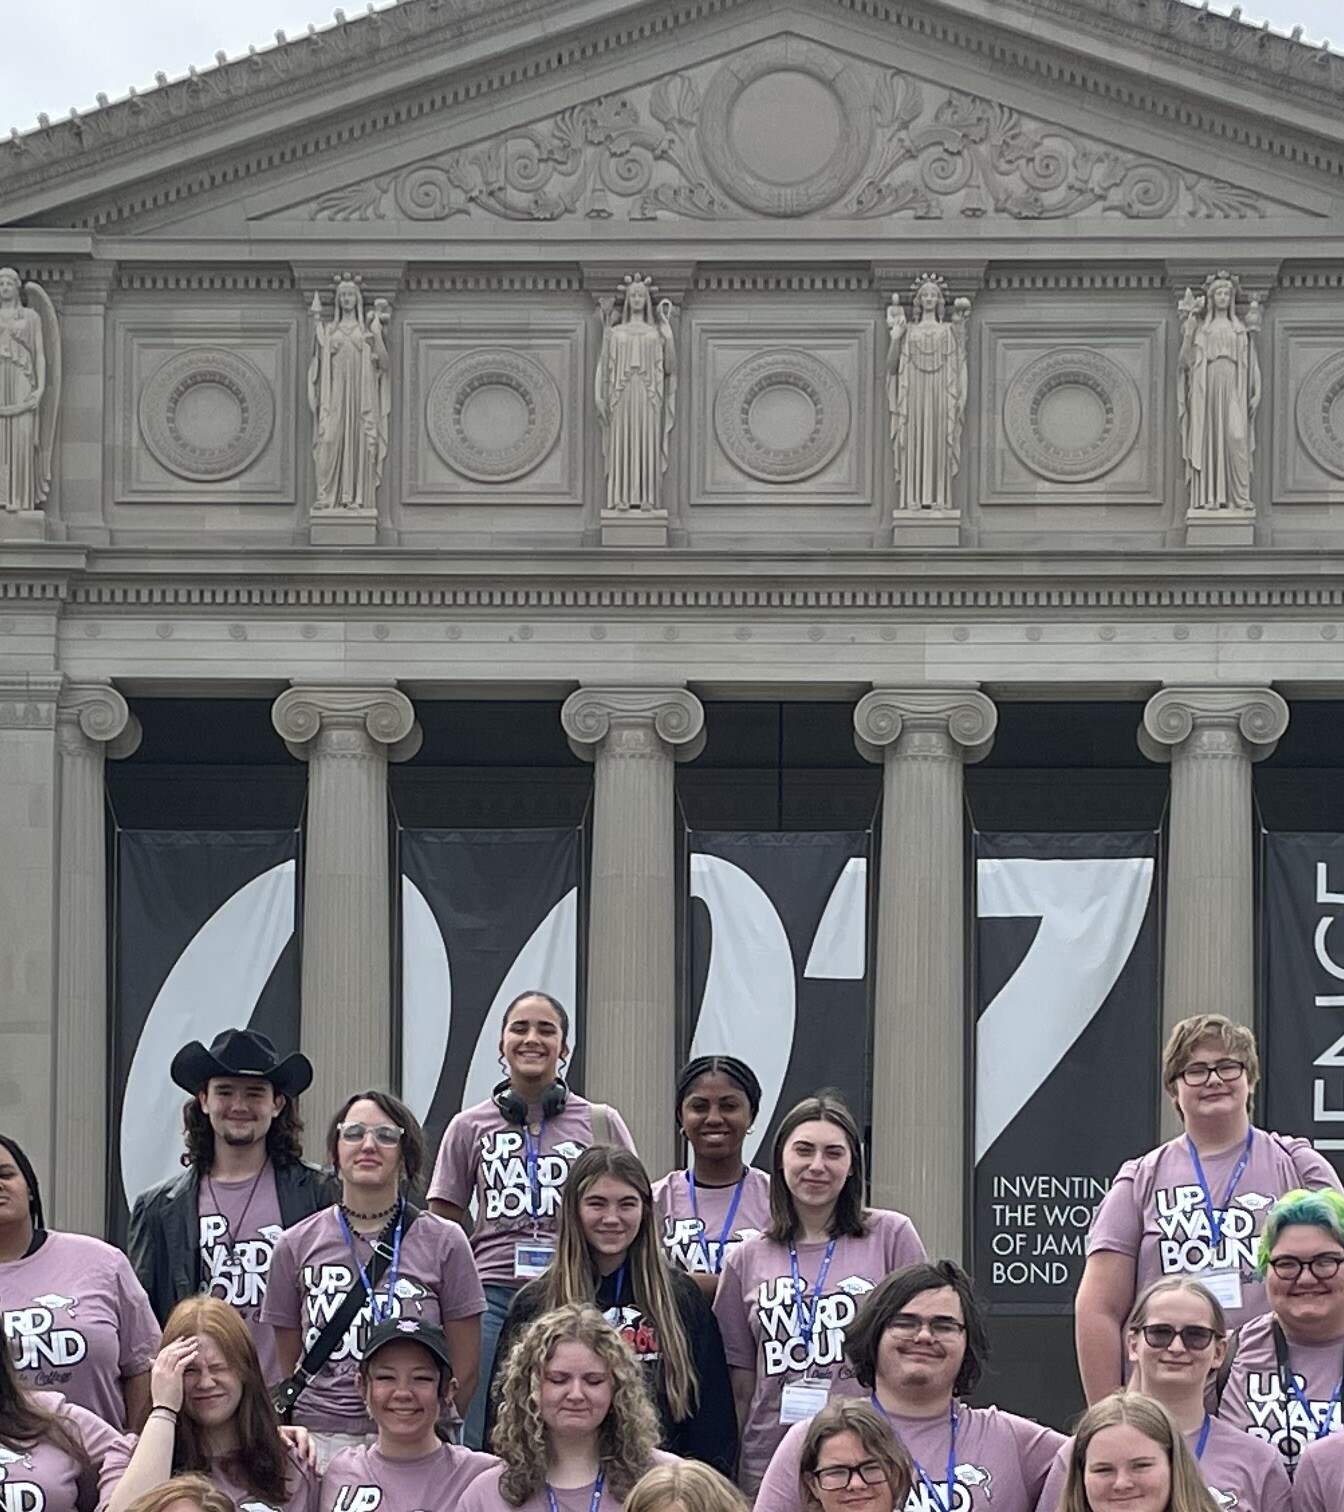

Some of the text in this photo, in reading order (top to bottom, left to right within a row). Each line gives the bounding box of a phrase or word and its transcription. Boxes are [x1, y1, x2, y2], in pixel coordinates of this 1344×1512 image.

[481, 1132, 523, 1162] UP
[992, 1176, 1110, 1199] INVENTIN
[1156, 1184, 1205, 1214] UP
[992, 1205, 1037, 1227] THE
[663, 1218, 706, 1248] UP
[992, 1233, 1030, 1256] OF
[304, 1265, 352, 1296] UP
[992, 1262, 1069, 1285] BOND
[759, 1276, 807, 1309] UP
